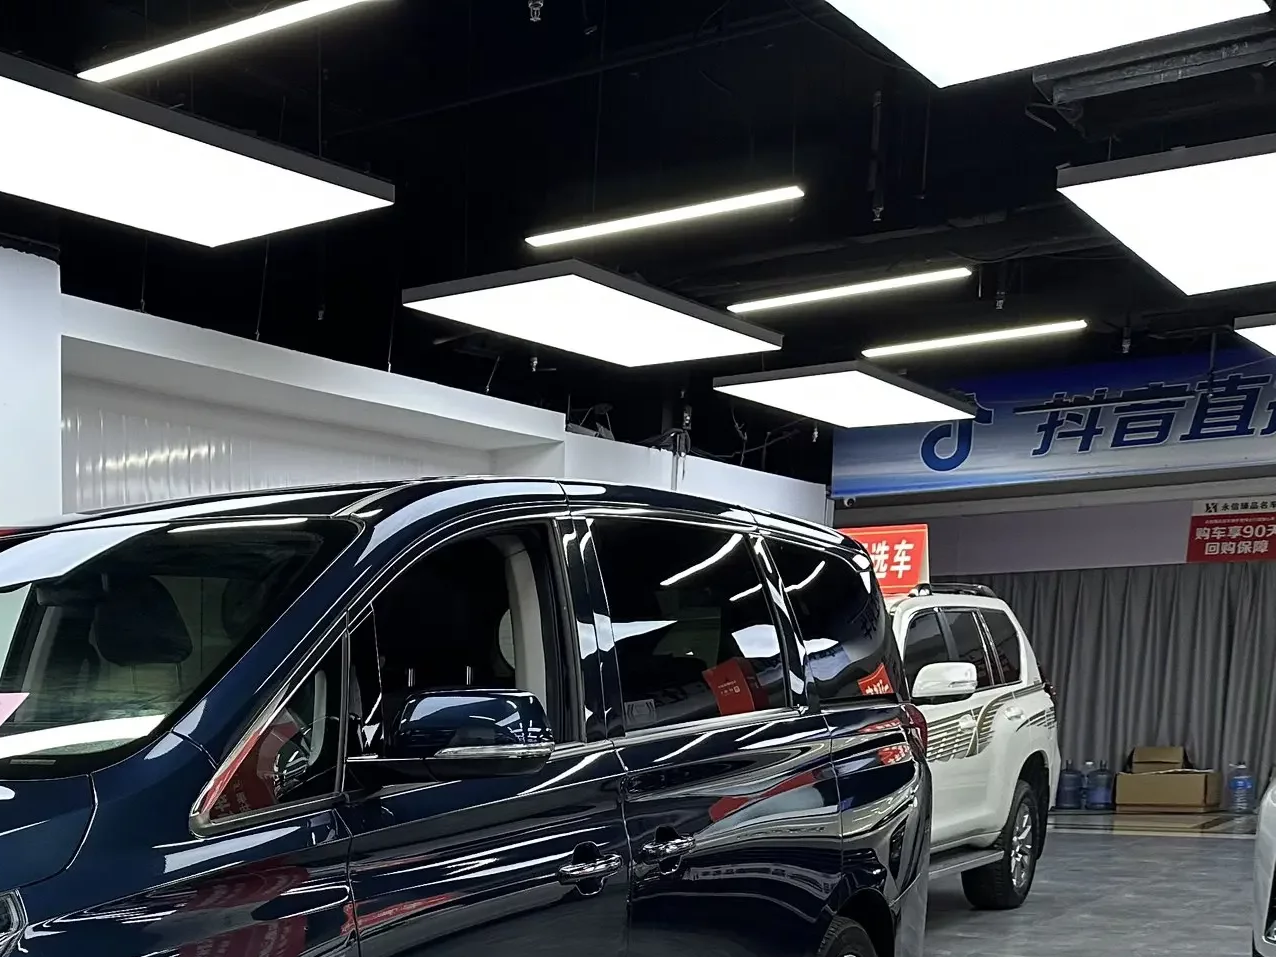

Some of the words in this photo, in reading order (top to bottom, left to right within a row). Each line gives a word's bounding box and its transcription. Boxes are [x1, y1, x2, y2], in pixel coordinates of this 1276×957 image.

[1030, 372, 1276, 457] 抖音直
[1204, 539, 1270, 556] 回购保障
